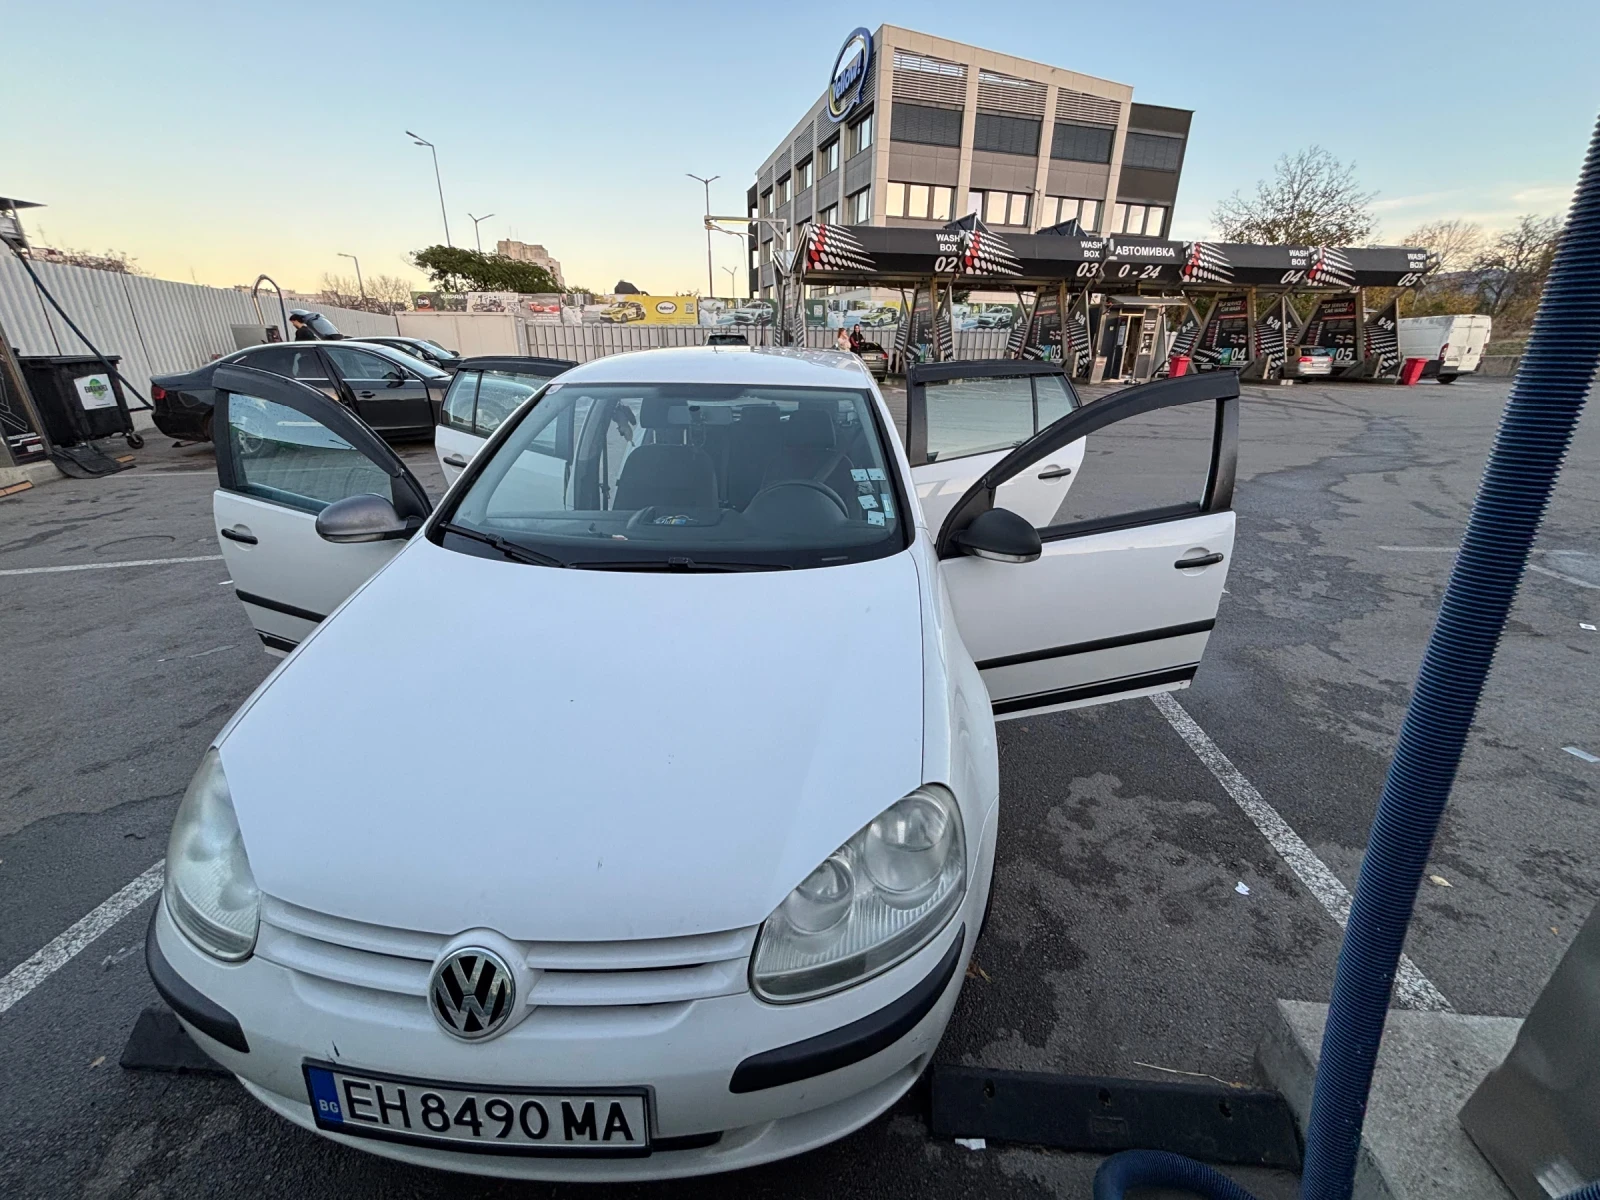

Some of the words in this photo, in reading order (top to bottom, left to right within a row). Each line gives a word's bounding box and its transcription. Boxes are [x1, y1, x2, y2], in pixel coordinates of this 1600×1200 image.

[935, 233, 961, 243] WASH
[1080, 241, 1103, 249] WASH
[940, 244, 957, 252] BOX
[1084, 250, 1100, 258] BOX
[1115, 245, 1175, 257] АВТОМИВКА
[1289, 249, 1309, 257] WASH
[934, 256, 957, 272] 02
[1291, 258, 1306, 266] BOX
[1407, 253, 1426, 261] WASH
[1076, 262, 1099, 278] 03
[1139, 265, 1162, 279] 24
[1409, 261, 1424, 269] BOX
[1280, 270, 1305, 284] 04
[1397, 272, 1423, 287] 05
[1266, 315, 1281, 330] 0-24
[1378, 317, 1395, 330] 0-24
[1050, 345, 1061, 359] 03
[1231, 347, 1246, 361] 04
[1335, 347, 1354, 361] 05
[319, 1098, 339, 1113] BG
[342, 1078, 412, 1129] EH
[420, 1091, 550, 1140] 8490
[561, 1100, 634, 1141] MA
